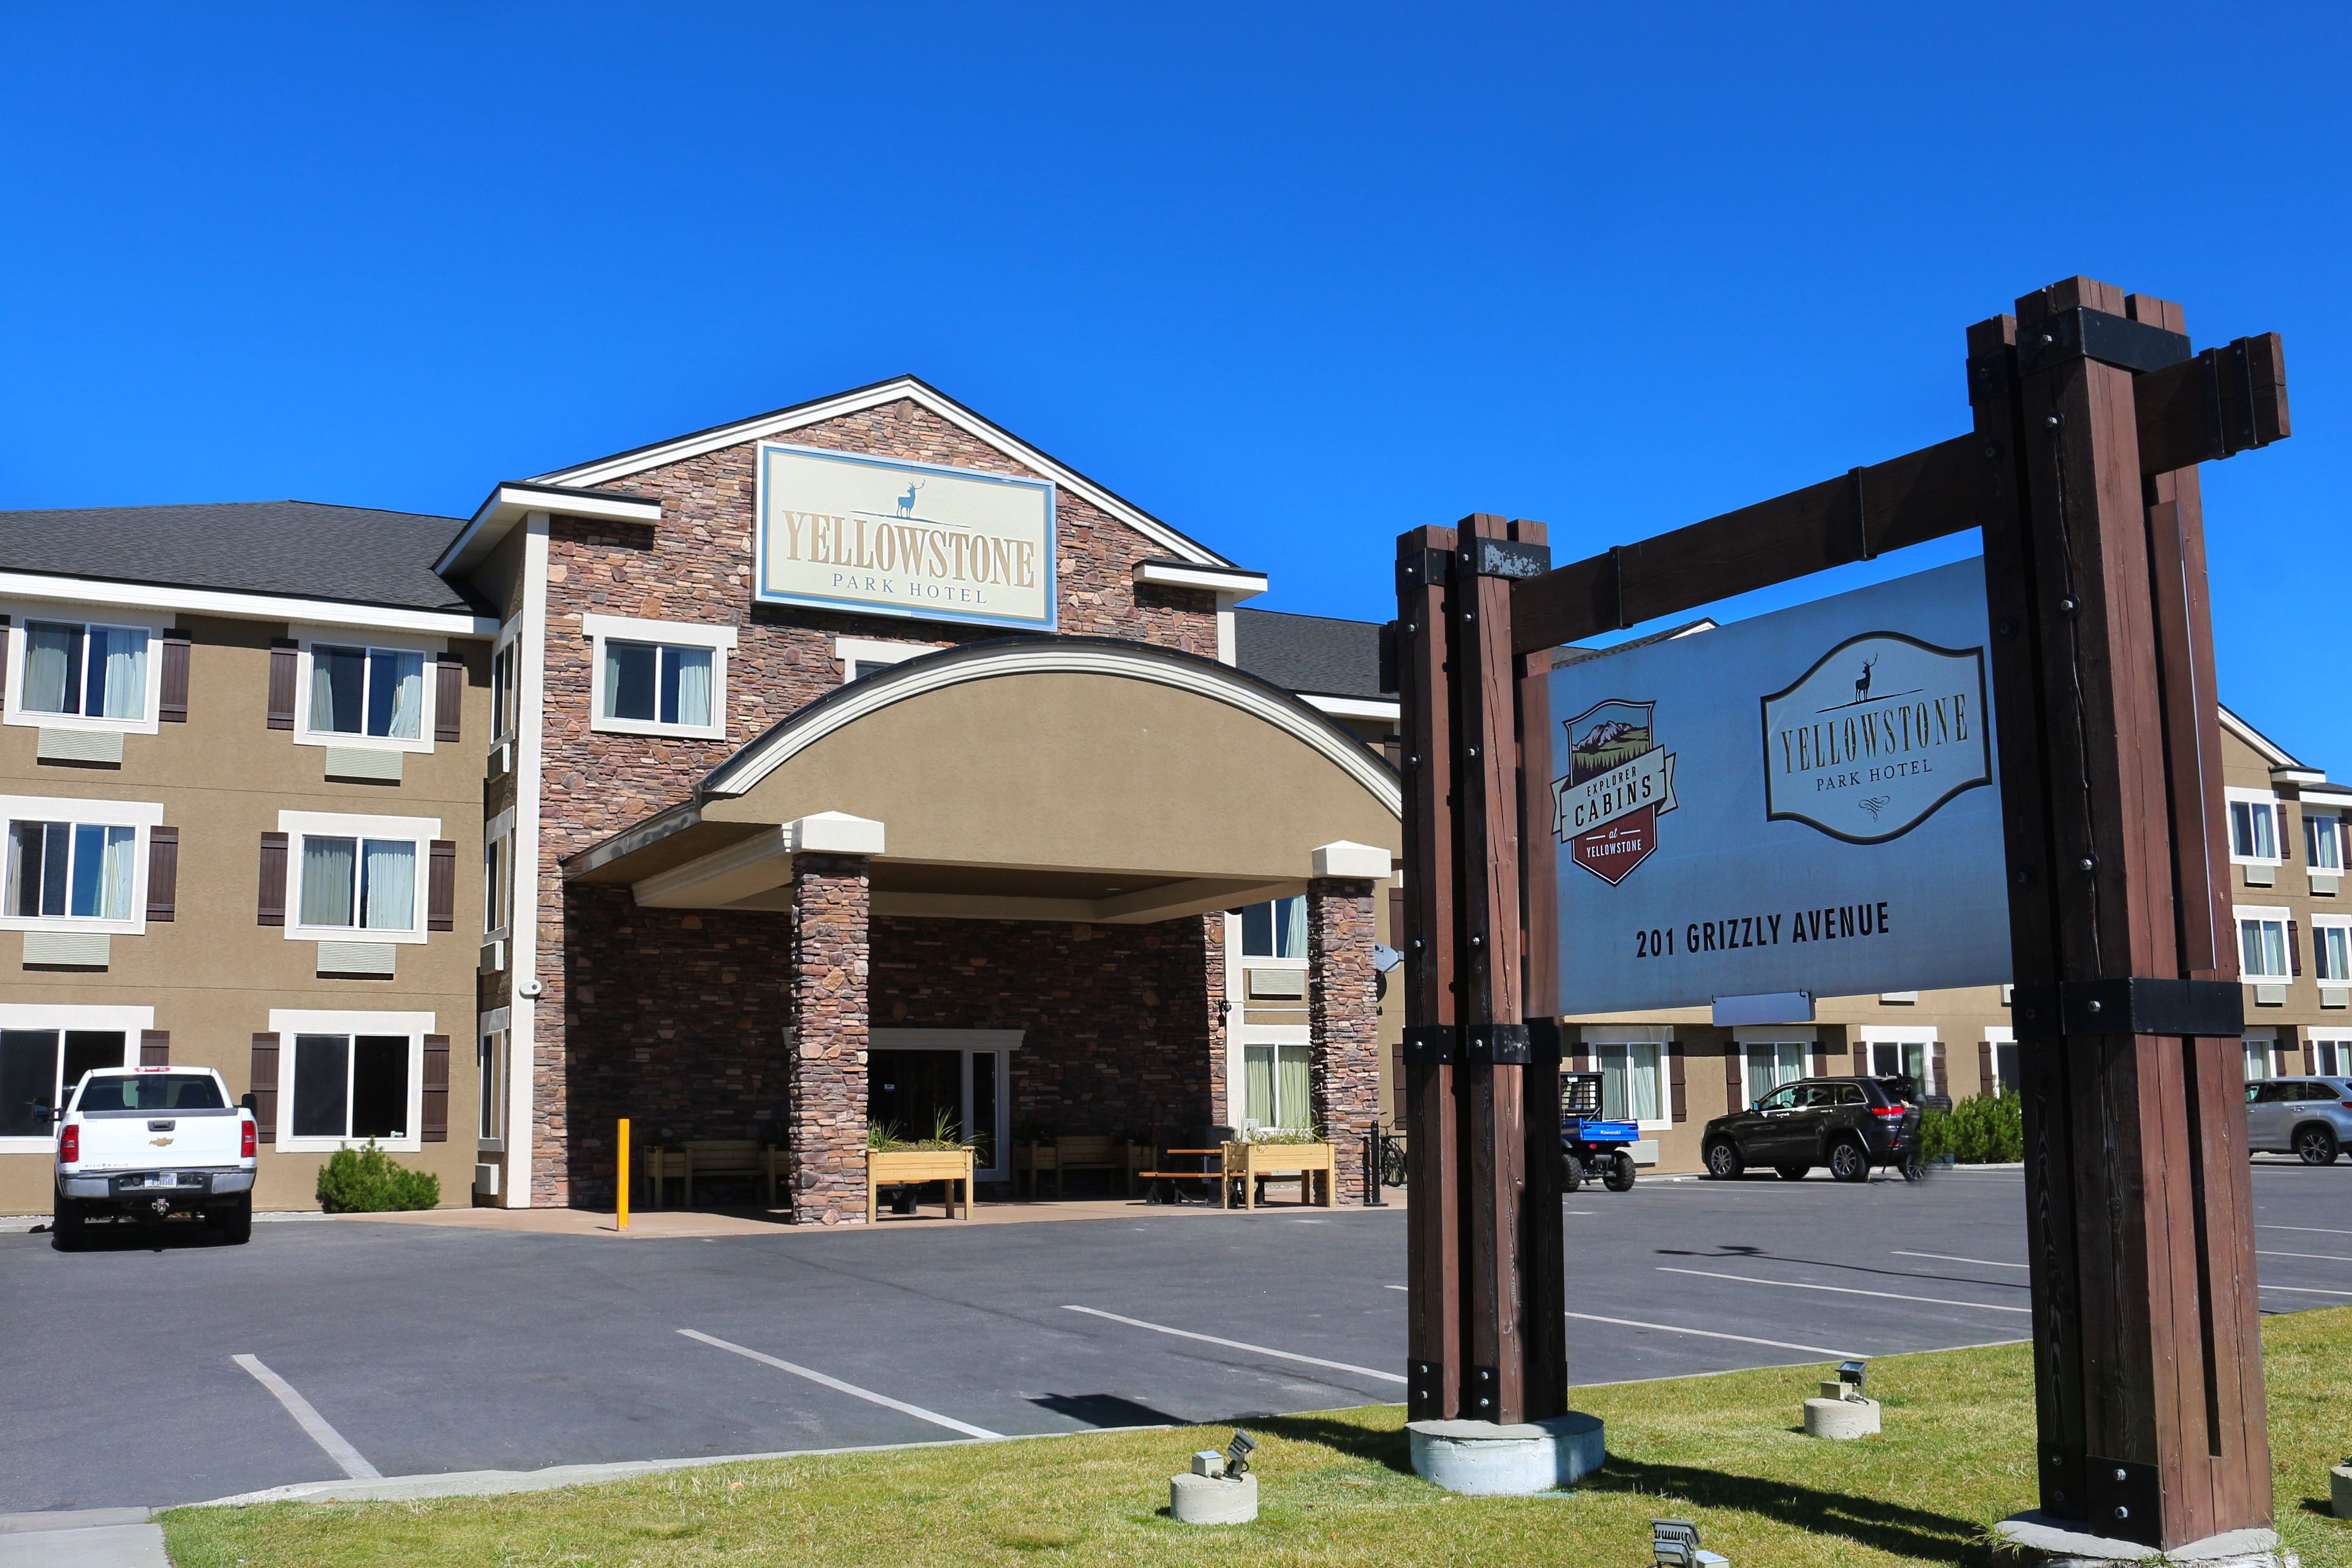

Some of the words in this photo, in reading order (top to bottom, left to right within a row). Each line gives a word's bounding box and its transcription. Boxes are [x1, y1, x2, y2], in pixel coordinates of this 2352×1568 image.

[782, 510, 1035, 589] YELLOWSTONE
[832, 573, 894, 594] PARK
[910, 582, 987, 605] HOTEL
[1781, 693, 1968, 774] YELLOWSTONE
[1587, 766, 1637, 797] EXPLORER
[1817, 771, 1861, 792] PARK
[1869, 759, 1932, 783] HOTEL
[1575, 774, 1651, 827] CABINS
[1586, 839, 1642, 858] YELLOWSTONE
[1608, 827, 1618, 839] at
[1636, 927, 1673, 958] 201
[1686, 914, 1782, 954] GRIZZLY
[1792, 902, 1890, 943] AVENUE
